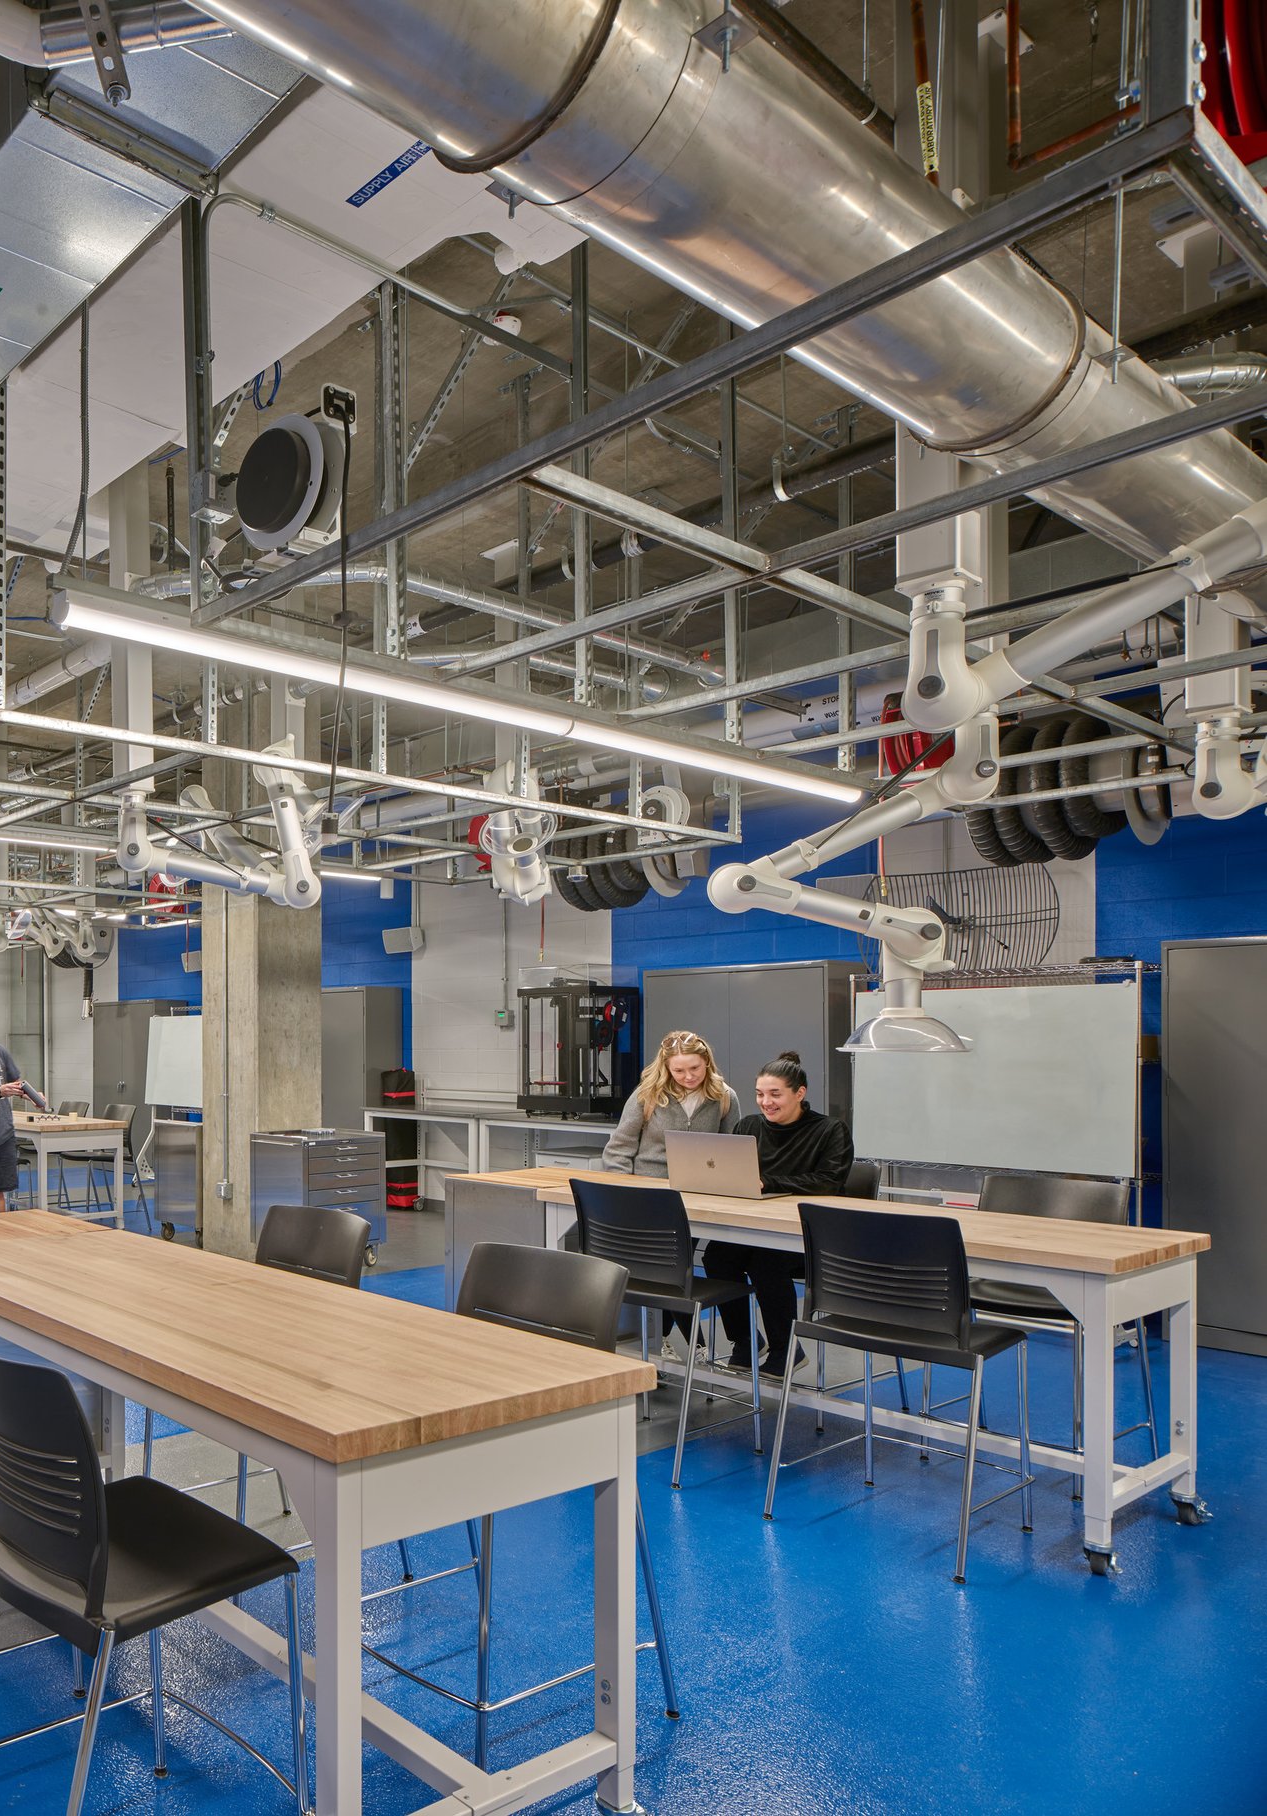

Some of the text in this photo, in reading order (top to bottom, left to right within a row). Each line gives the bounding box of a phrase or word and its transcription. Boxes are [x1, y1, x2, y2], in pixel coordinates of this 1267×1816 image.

[924, 87, 935, 159] LABORATORY AIR
[352, 170, 393, 204] SUPPLY
